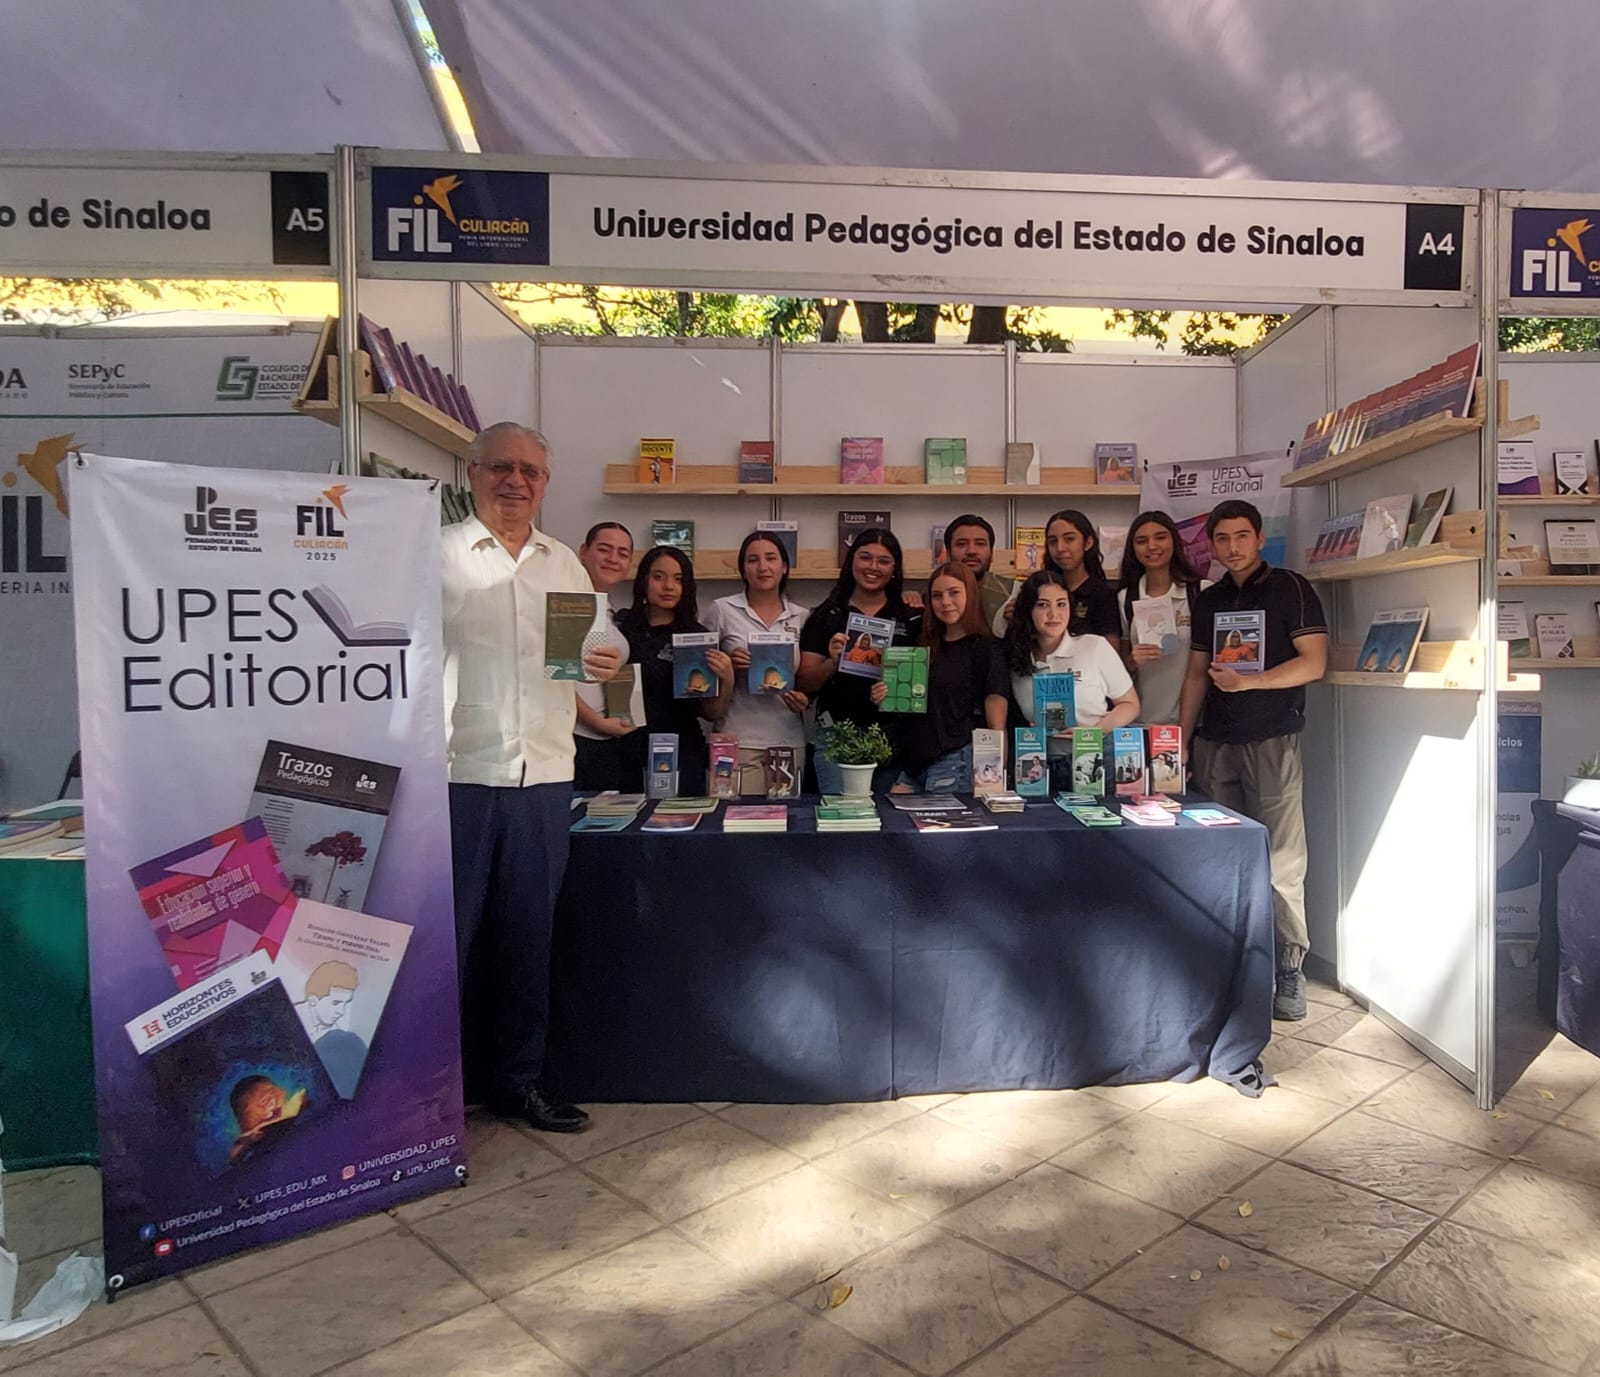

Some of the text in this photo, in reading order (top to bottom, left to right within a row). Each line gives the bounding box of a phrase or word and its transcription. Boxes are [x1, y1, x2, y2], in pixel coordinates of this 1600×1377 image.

[28, 198, 71, 228] de
[83, 199, 211, 231] Sinaloa
[286, 207, 325, 233] A5
[593, 206, 1365, 257] Universidad Pedagógica del Estado de Sinaloa
[1418, 231, 1456, 256] A4
[68, 364, 126, 382] SEPyC
[262, 364, 299, 373] COLEGIO
[1212, 465, 1242, 481] UPES
[1210, 479, 1264, 495] Editorial
[306, 551, 337, 561] 2025
[121, 587, 299, 645] UPES
[123, 648, 409, 713] Editorial
[278, 751, 334, 778] Trazos
[277, 769, 331, 788] Pedagógicos
[161, 978, 233, 1021] HORIZONTES
[166, 986, 237, 1029] EDUCATIVOS
[359, 1134, 457, 1172] UNIVERSIDAD_UPES
[176, 1176, 382, 1248] Universidad Pedagógica del Estado de Sinaloa
